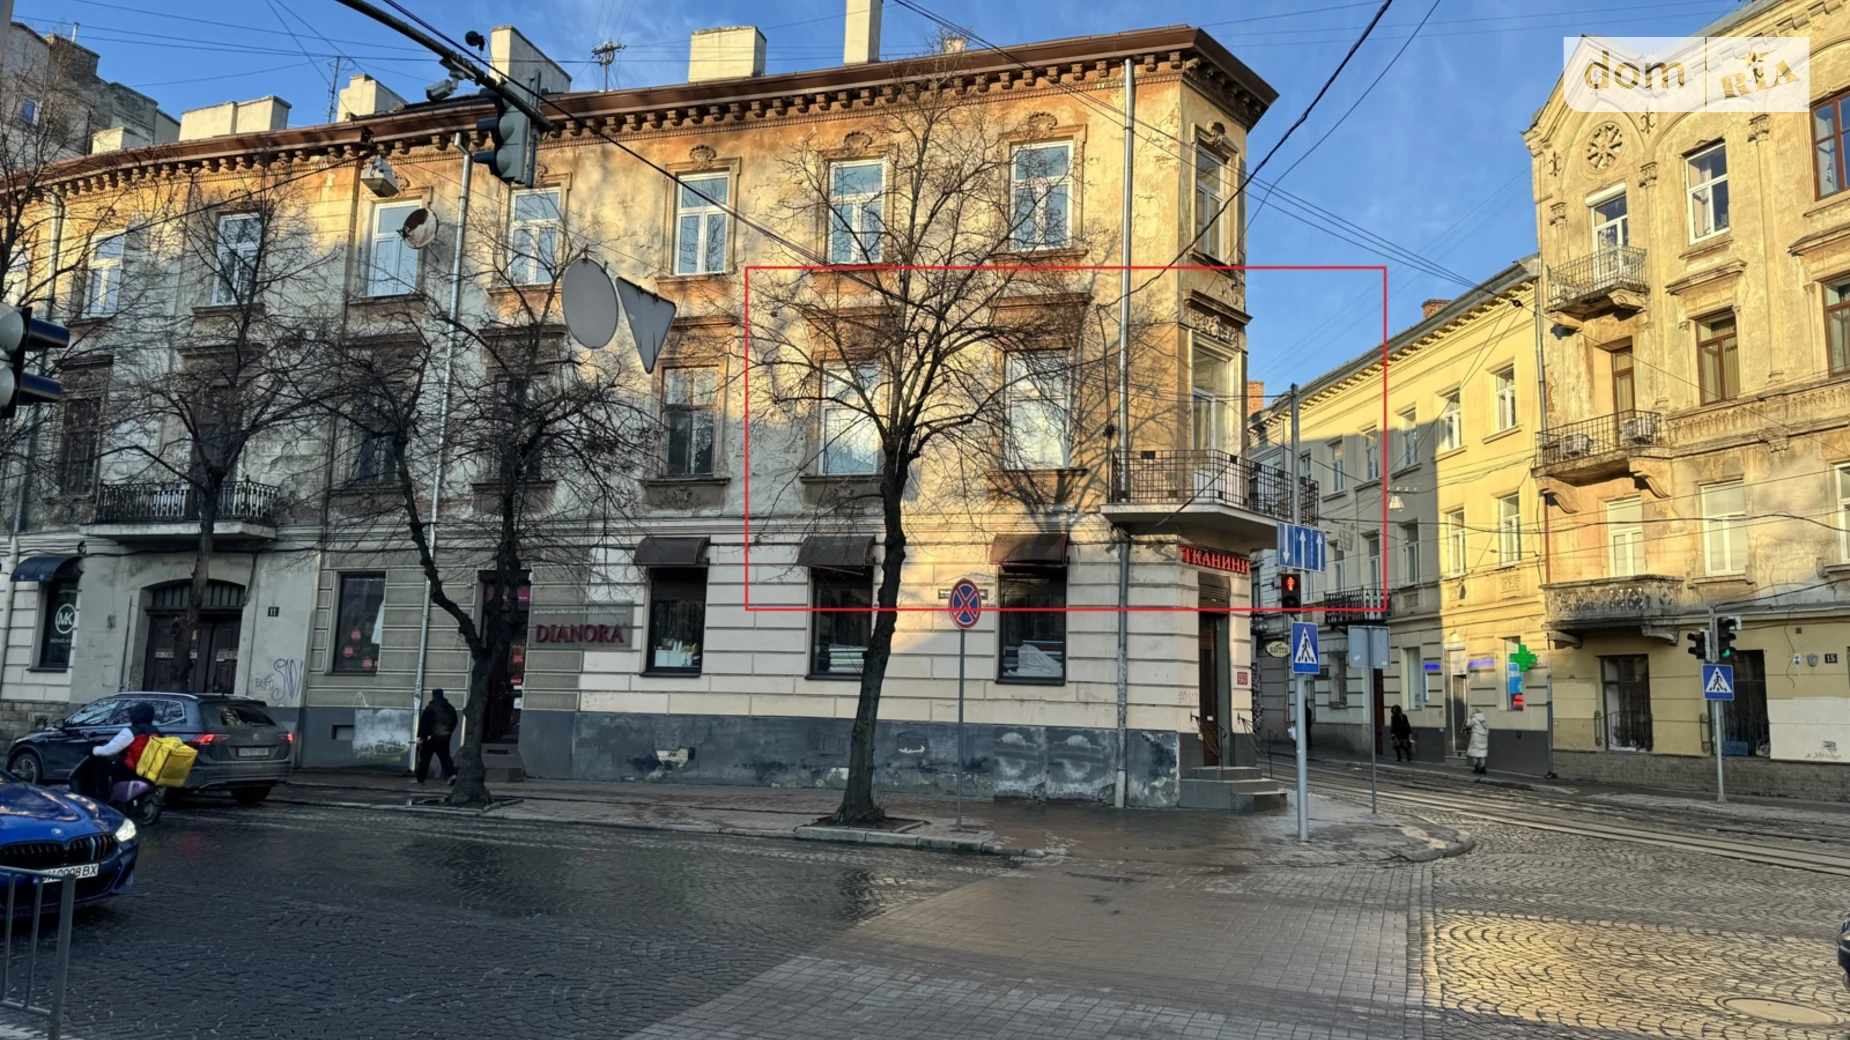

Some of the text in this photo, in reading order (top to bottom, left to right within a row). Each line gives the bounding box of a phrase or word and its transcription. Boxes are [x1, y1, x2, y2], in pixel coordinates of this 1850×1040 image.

[1178, 546, 1250, 574] ТКАНИНИ
[58, 612, 73, 626] MK
[535, 624, 625, 643] DIANORA
[1826, 654, 1836, 662] 15
